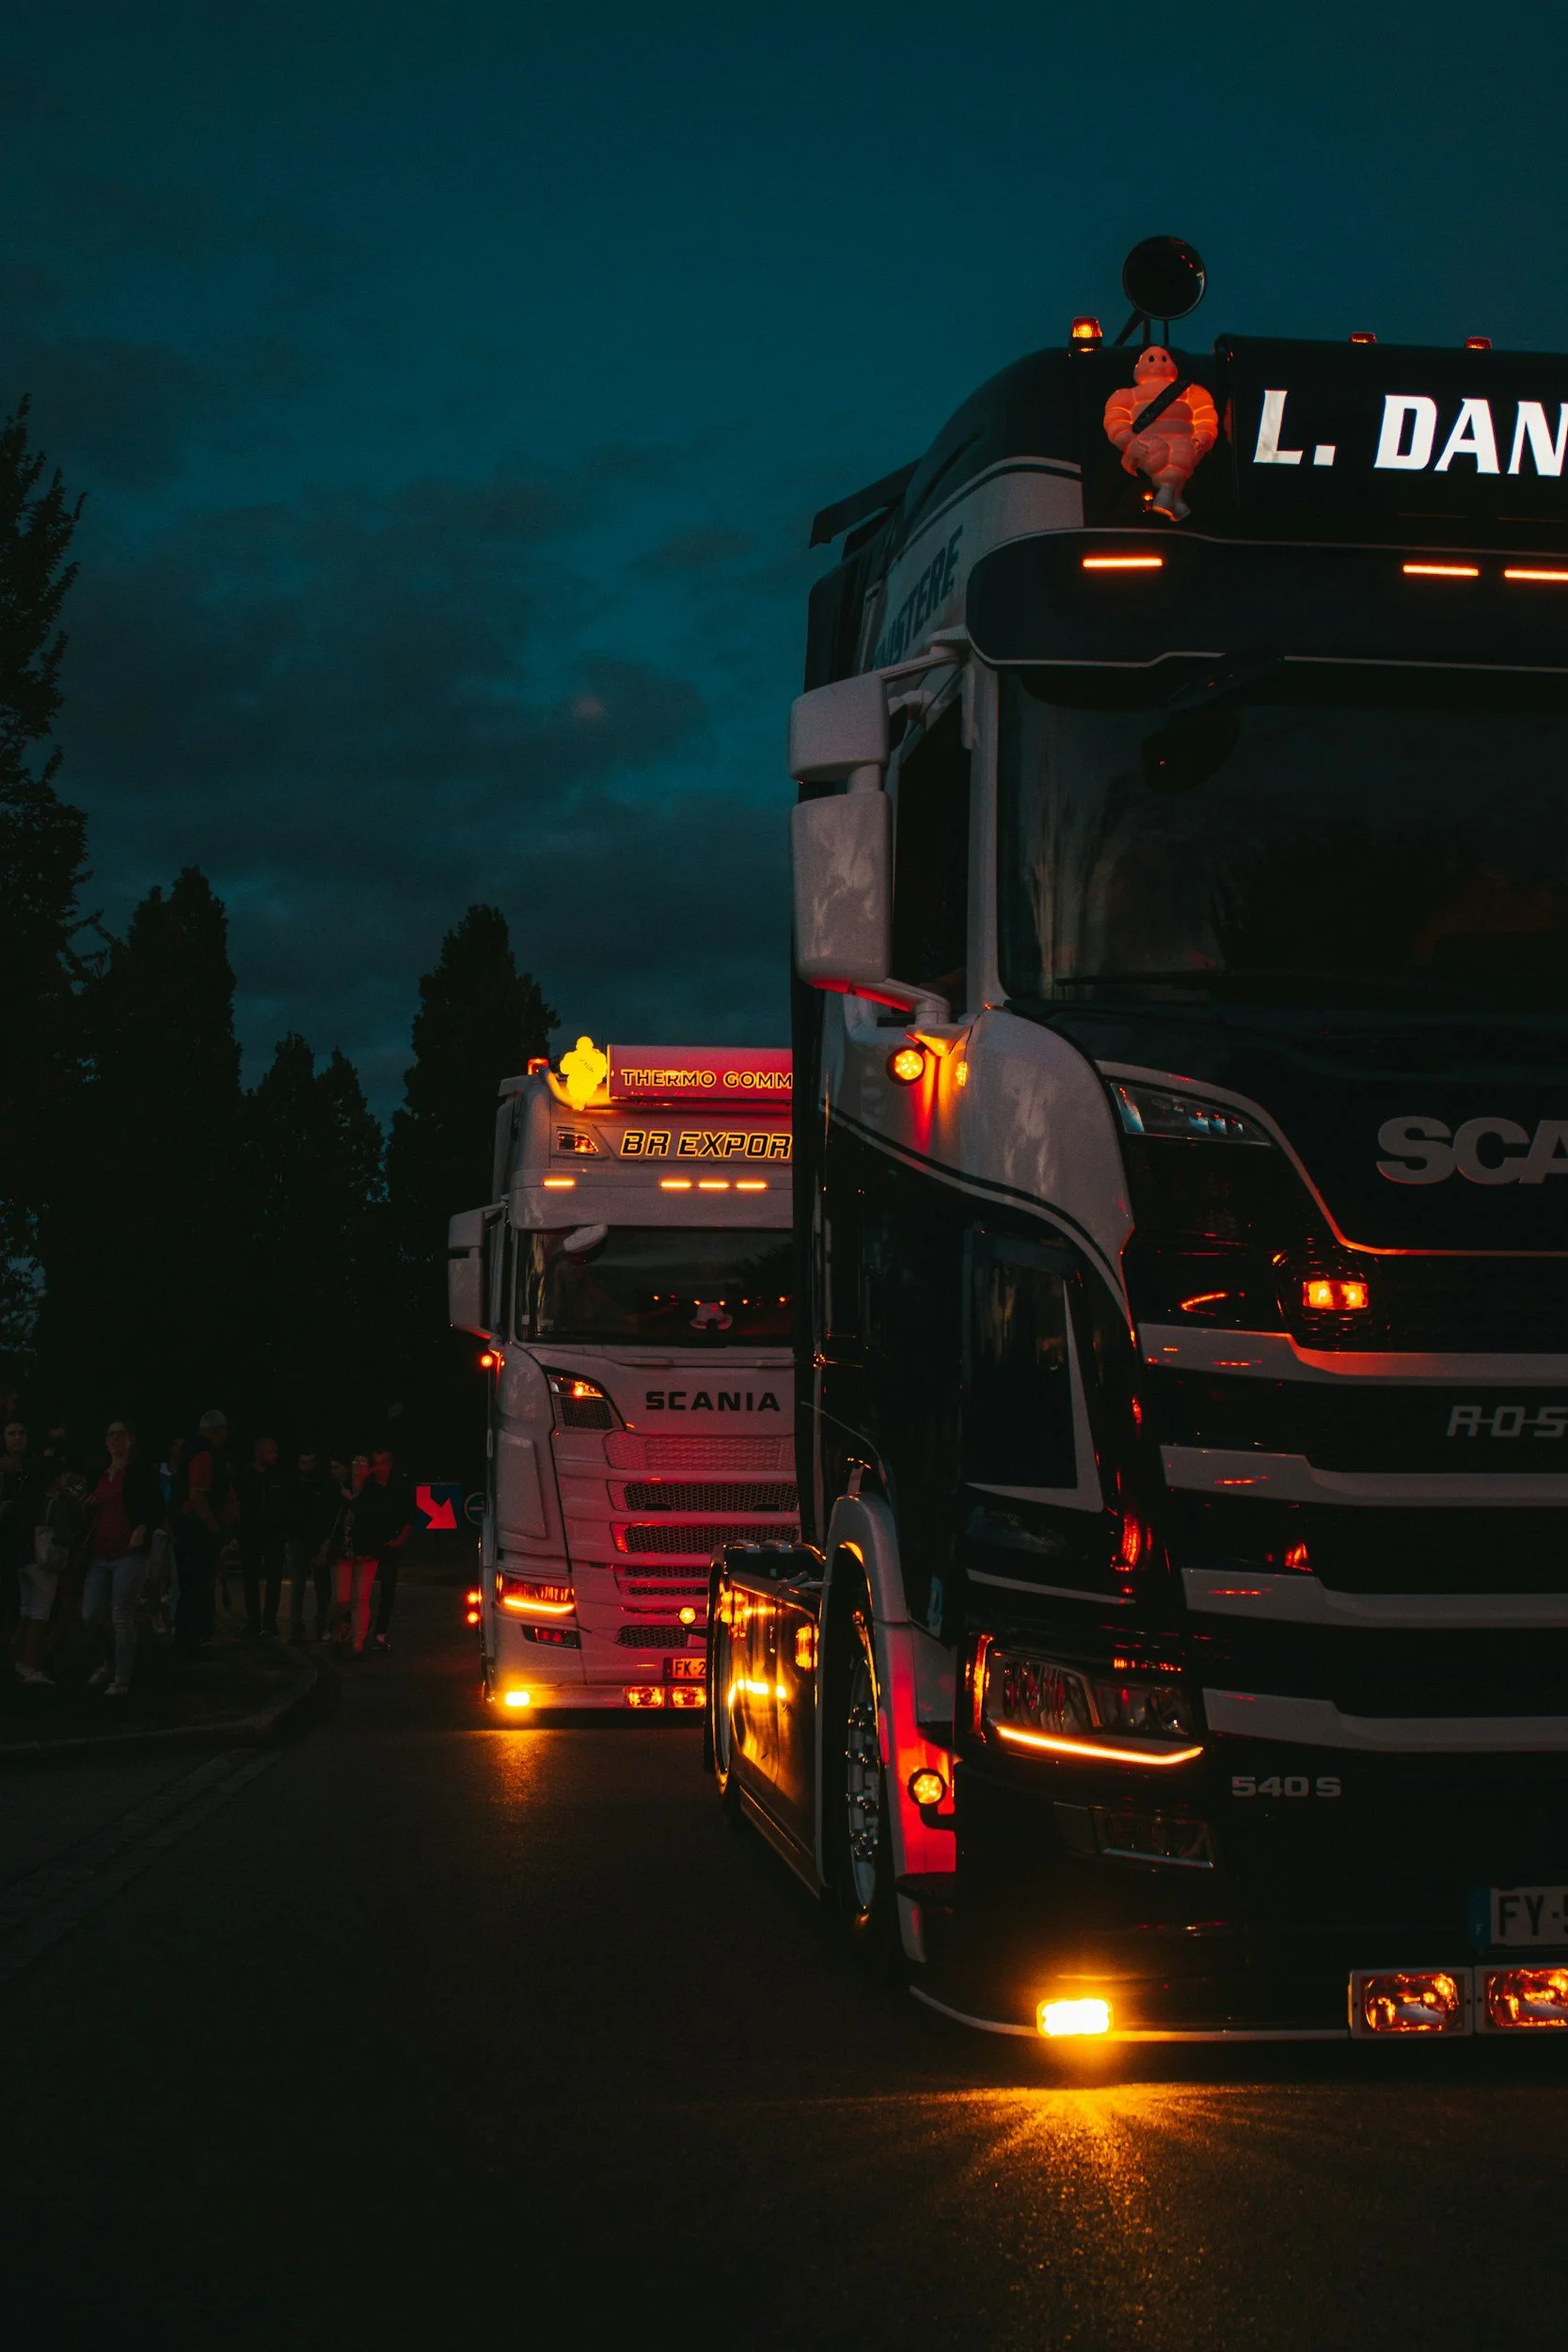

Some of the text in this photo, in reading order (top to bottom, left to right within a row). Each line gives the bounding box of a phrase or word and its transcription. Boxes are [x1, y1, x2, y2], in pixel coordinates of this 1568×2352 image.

[1252, 389, 1568, 477] L. DAN
[620, 1069, 793, 1089] THERMO GOMM
[620, 1130, 793, 1159] BR EXPOR
[1375, 1115, 1568, 1186] SCA
[645, 1391, 781, 1411] SCANIA
[1230, 1775, 1343, 1799] 540 S
[1497, 1893, 1568, 1937] FY-
